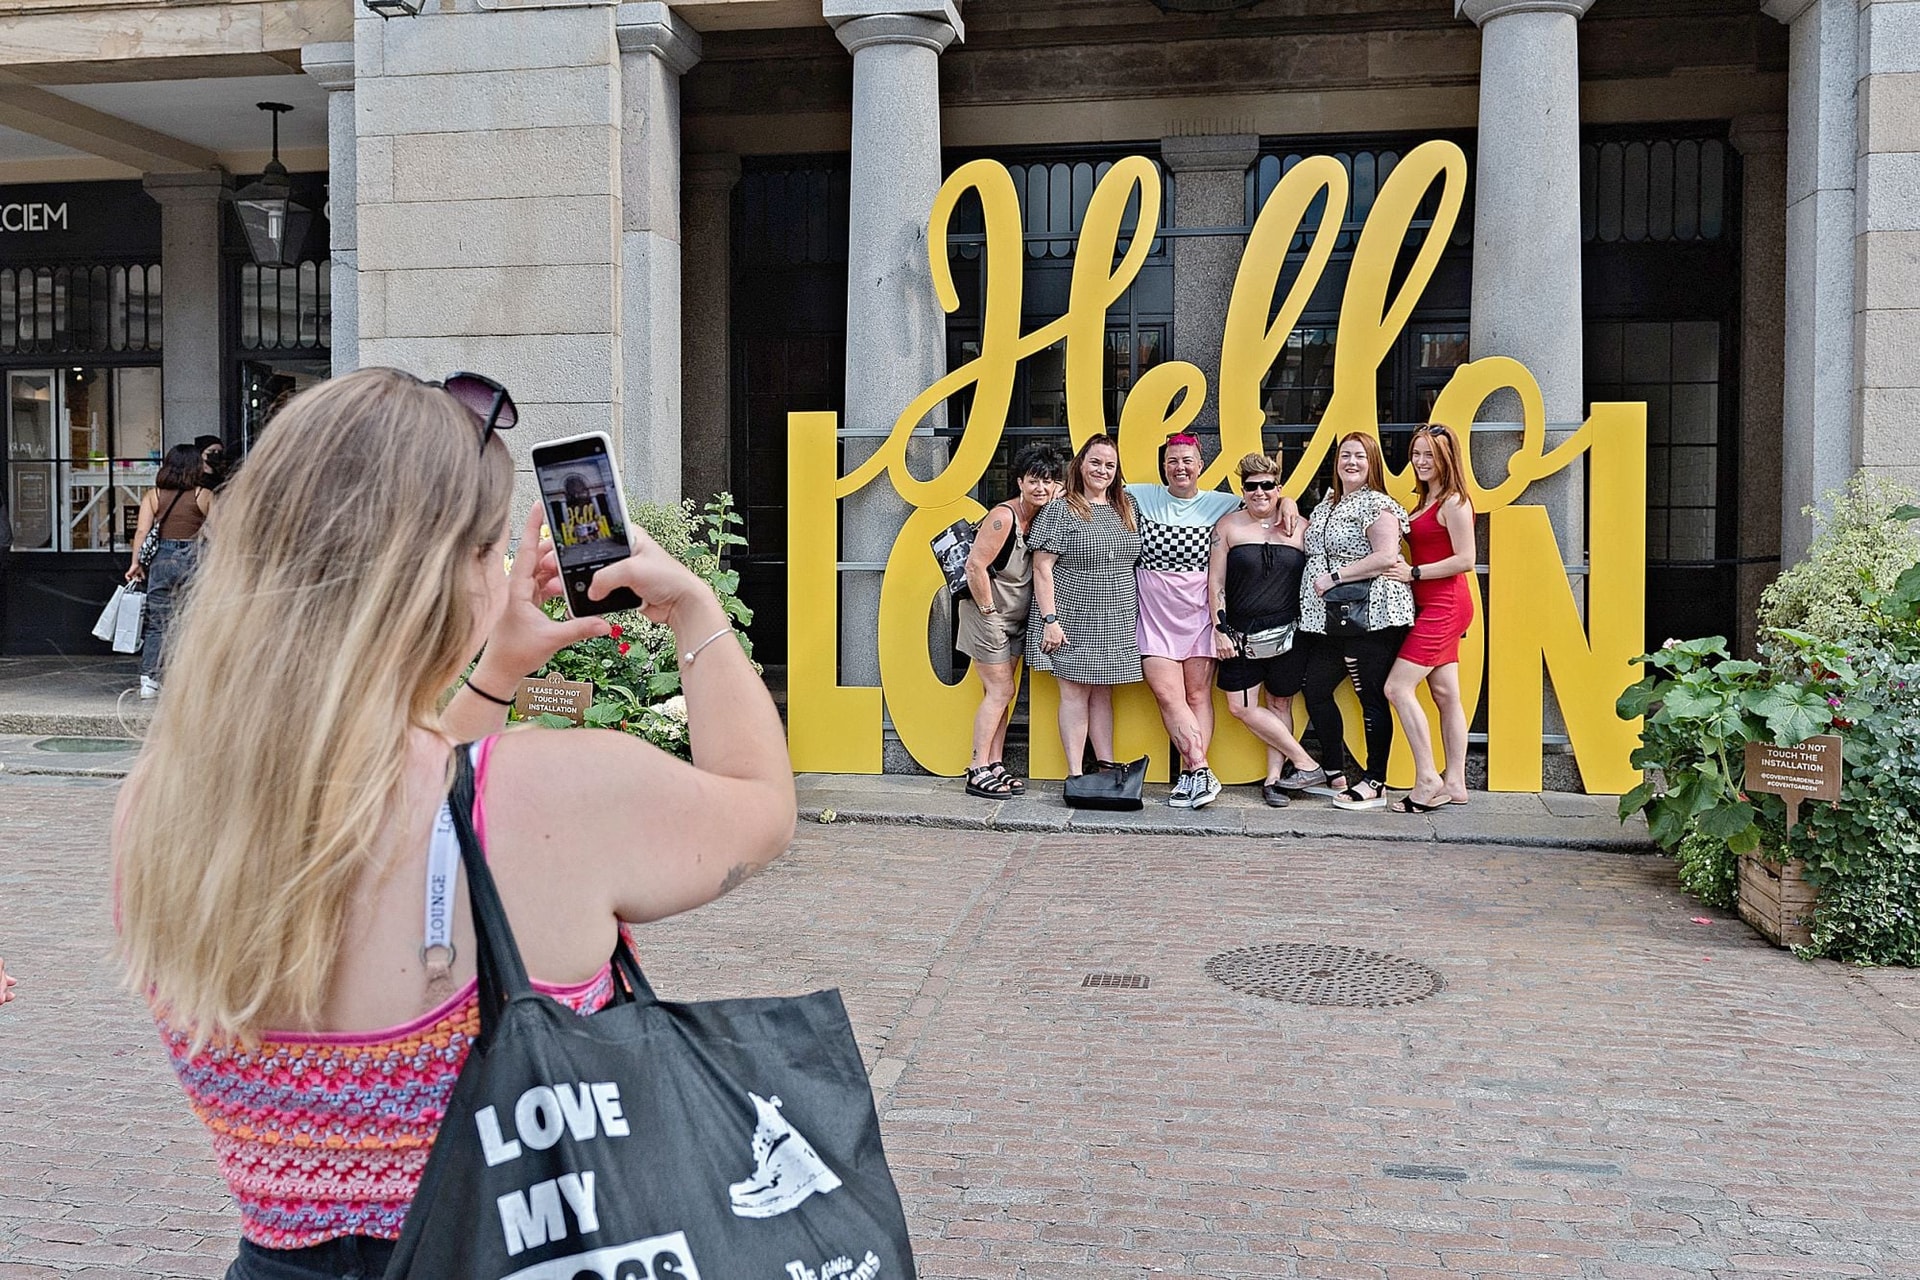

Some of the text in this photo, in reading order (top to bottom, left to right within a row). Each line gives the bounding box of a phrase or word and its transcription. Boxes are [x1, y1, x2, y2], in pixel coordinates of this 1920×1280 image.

[0, 202, 68, 231] CIEM
[837, 139, 1595, 513] Hello
[527, 686, 553, 695] PLEASE
[534, 695, 574, 705] TOUCH THE
[528, 703, 578, 714] INSTALLATION
[1808, 744, 1828, 753] NOT
[1767, 749, 1818, 762] TOUCH THE
[1761, 758, 1824, 772] INSTALLATION
[1760, 773, 1825, 786] @COVENTGARDENLDN
[1767, 781, 1818, 792] #COVENTGARDEN
[430, 874, 447, 941] LOUNGE
[475, 1081, 631, 1167] LOVE
[496, 1170, 600, 1257] MY
